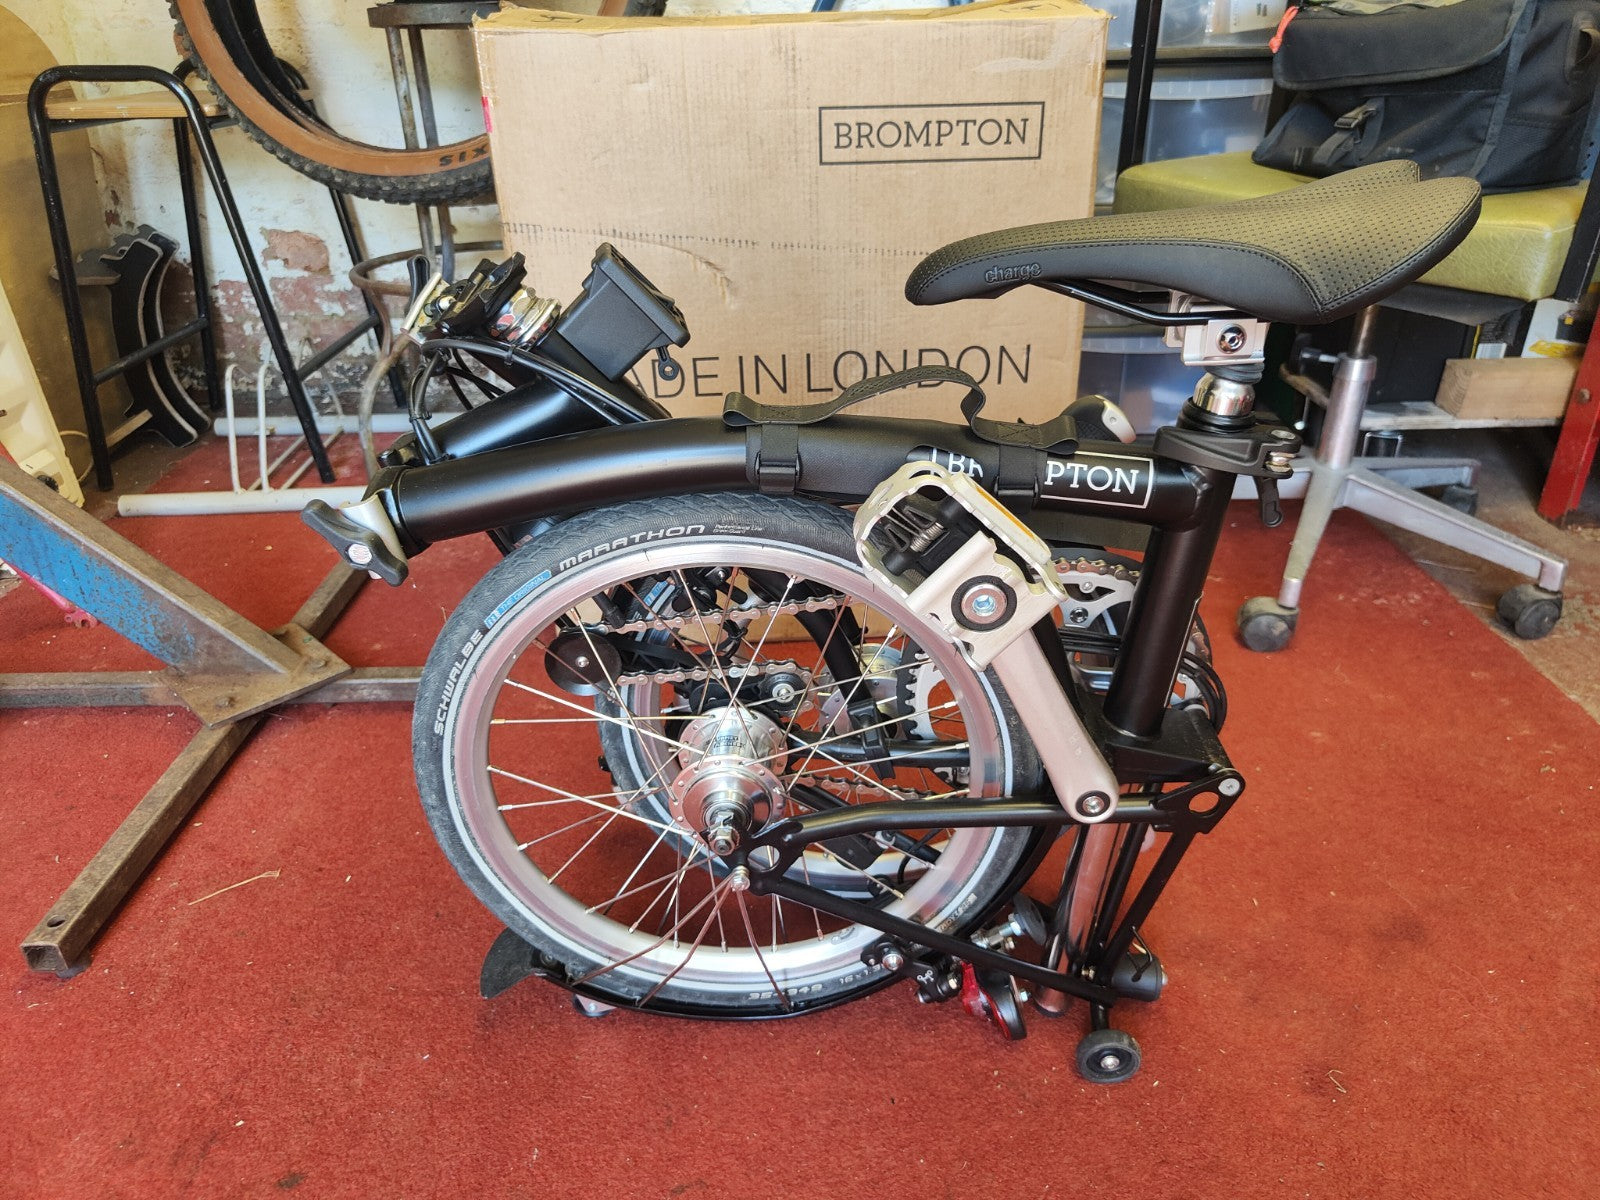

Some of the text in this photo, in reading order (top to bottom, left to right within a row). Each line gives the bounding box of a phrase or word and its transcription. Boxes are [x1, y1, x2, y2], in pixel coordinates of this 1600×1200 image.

[834, 118, 1029, 150] BROMPTON
[439, 143, 489, 167] SIX
[984, 263, 1042, 283] charge
[738, 353, 788, 397] IN
[805, 344, 1031, 393] LONDON
[434, 629, 484, 735] SCHWALBE
[559, 523, 706, 572] MARATHON
